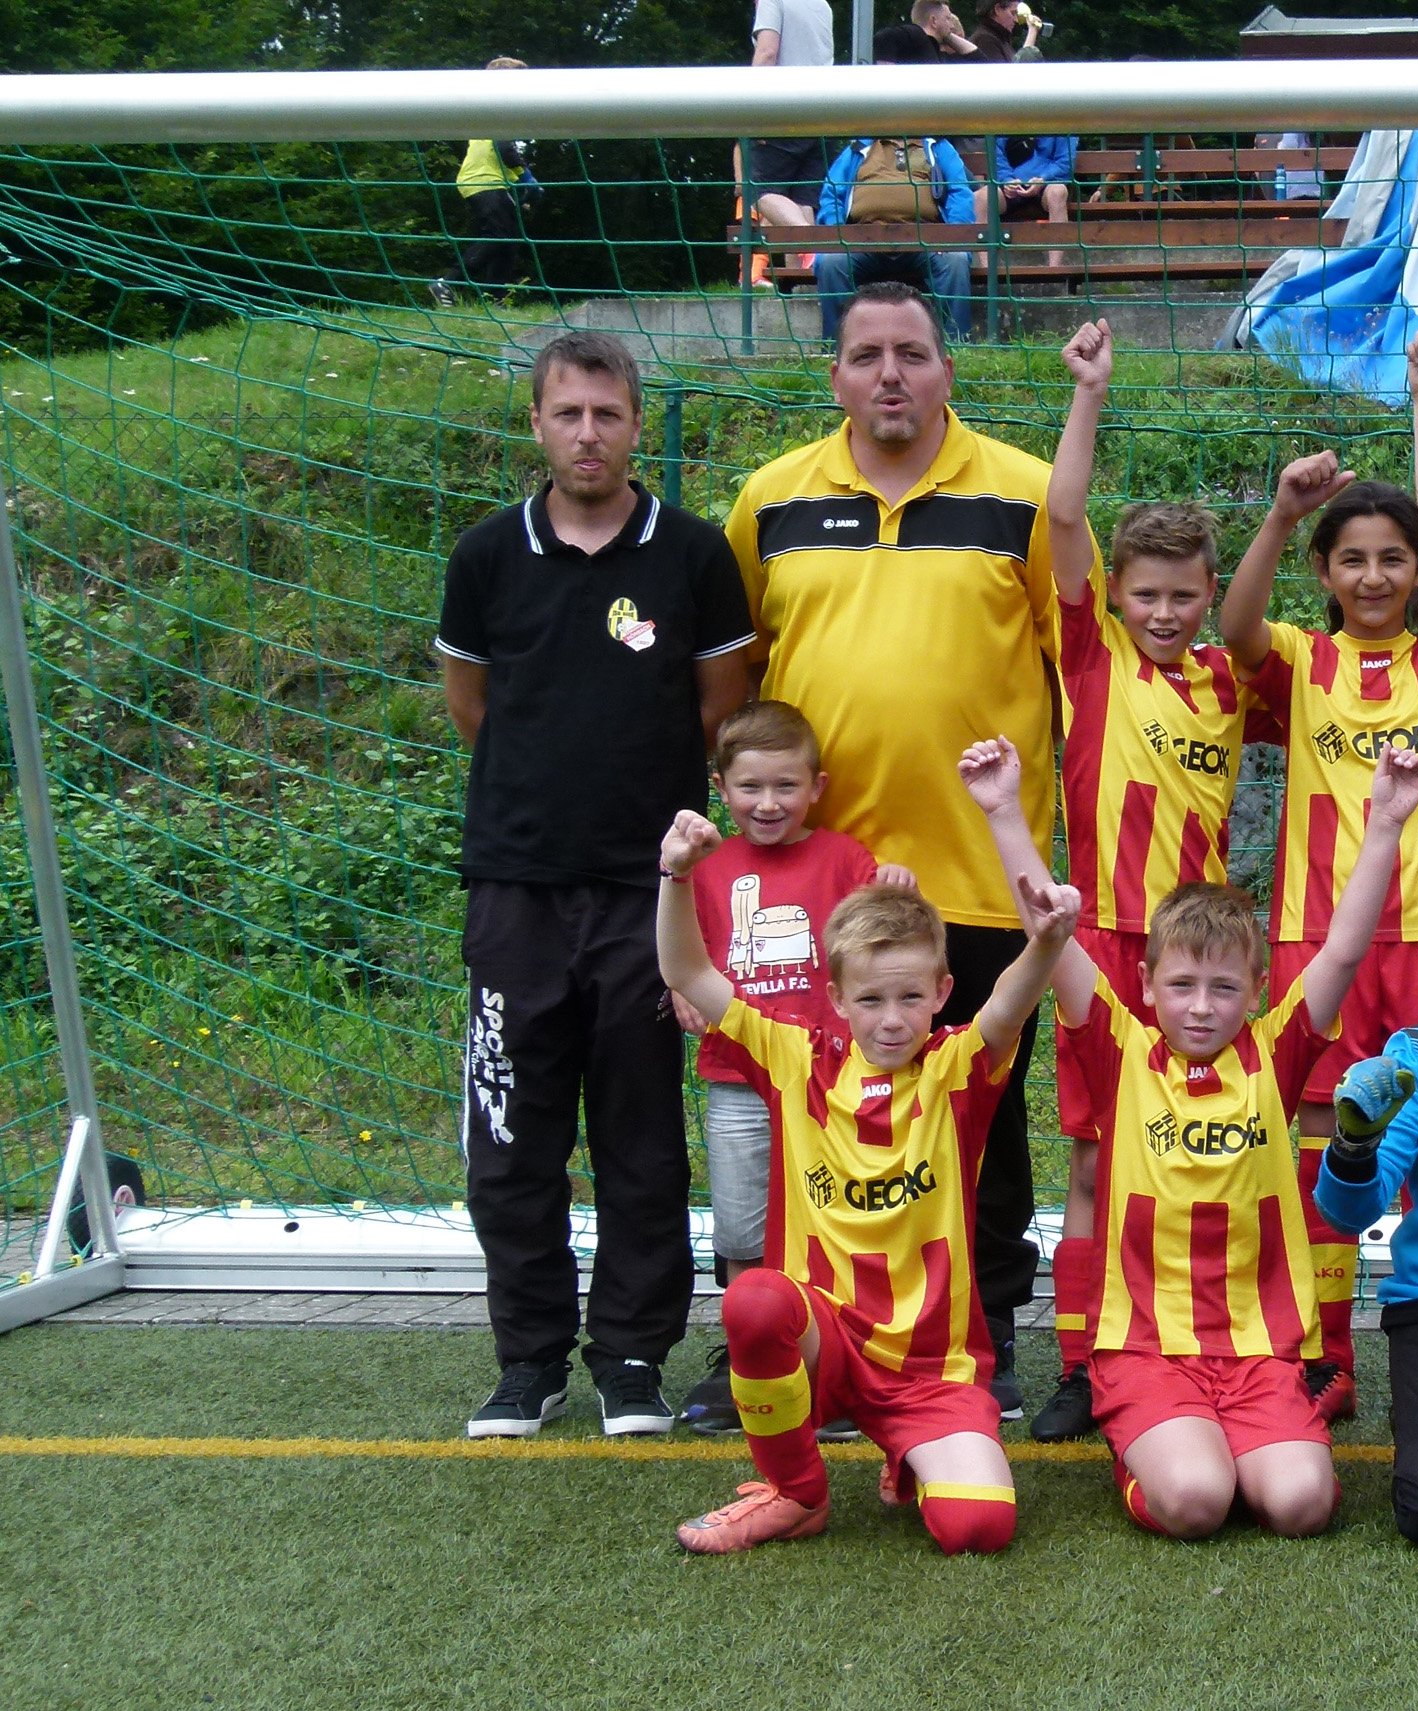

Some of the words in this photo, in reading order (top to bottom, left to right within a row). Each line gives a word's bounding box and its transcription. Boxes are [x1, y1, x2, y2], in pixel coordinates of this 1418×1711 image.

[835, 519, 859, 528] JAKO
[1361, 659, 1392, 669] JAKO
[741, 980, 785, 995] EVILLA
[789, 977, 811, 989] F.C.
[482, 987, 515, 1088] SPORT
[1188, 1066, 1211, 1079] JAK
[862, 1083, 892, 1099] AKO
[844, 1159, 937, 1212] GEORG
